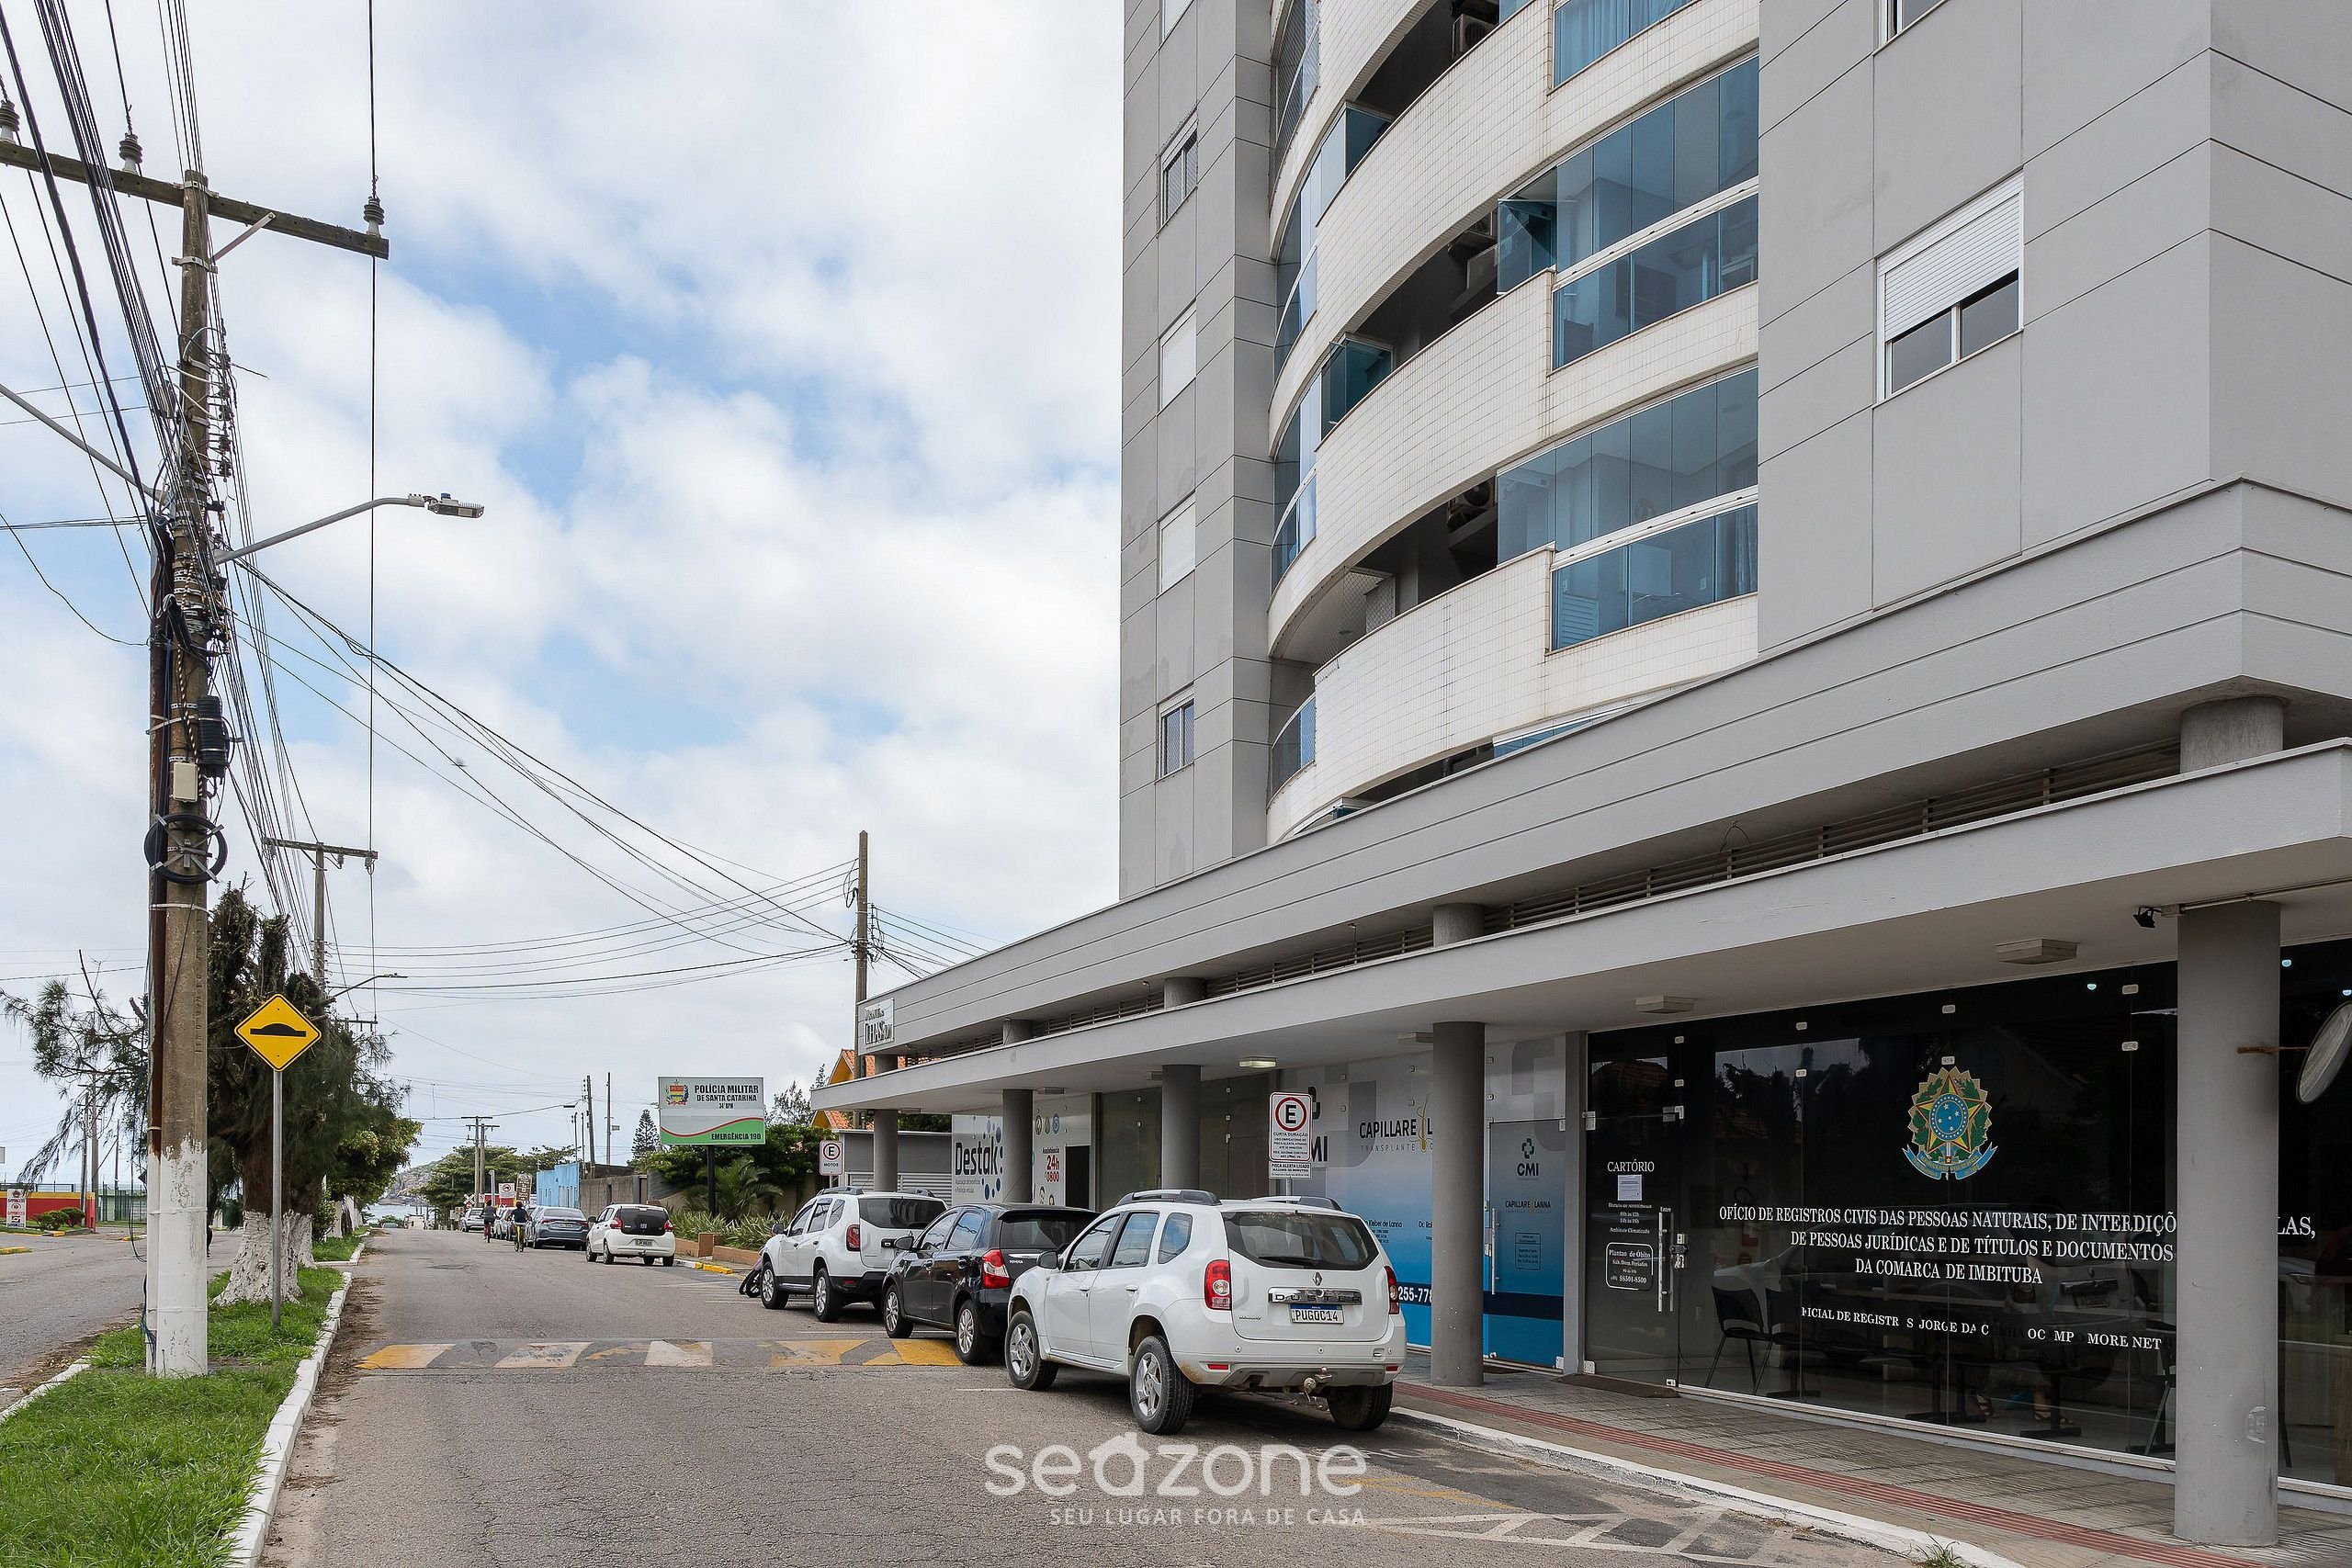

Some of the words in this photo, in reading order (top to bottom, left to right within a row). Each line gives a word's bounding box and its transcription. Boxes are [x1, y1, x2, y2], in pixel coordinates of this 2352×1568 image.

[695, 1083, 727, 1093] POLÍCIA
[728, 1084, 759, 1093] MILITAR
[1285, 1104, 1296, 1124] E
[711, 1132, 749, 1140] EMERGÊNCIA
[1360, 1119, 1417, 1139] CAPILLARE
[829, 1146, 835, 1156] E
[1361, 1143, 1415, 1153] TRANSPLANTE
[956, 1136, 998, 1175] Destak
[1046, 1155, 1059, 1170] 24h
[1517, 1163, 1539, 1176] CMI
[1607, 1158, 1655, 1172] CARTÓRIO
[1505, 1200, 1531, 1208] CAPILLARE
[1534, 1200, 1551, 1208] LANNA
[1720, 1203, 1756, 1221] OFÍCIO
[1758, 1207, 1772, 1221] DE
[1776, 1208, 1841, 1224] REGISTROS
[1844, 1209, 1876, 1224] CIVIS
[1880, 1210, 1905, 1225] DAS
[1908, 1211, 1968, 1228] PESSOAS
[1973, 1212, 2052, 1232] NATURAIS,
[2055, 1213, 2077, 1231] DE
[1791, 1231, 1806, 1246] DE
[1810, 1232, 1861, 1248] PESSOAS
[1865, 1233, 1935, 1252] JURÍDICAS
[1938, 1238, 1947, 1253] E
[1951, 1238, 1970, 1254] DE
[1974, 1235, 2038, 1257] TÍTULOS
[2041, 1240, 2052, 1257] E
[2056, 1240, 2174, 1261] DOCUMENTOS
[1856, 1258, 1872, 1274] DA
[1876, 1259, 1940, 1279] COMARCA
[1946, 1264, 1965, 1280] DE
[1969, 1265, 2042, 1284] IMBITUBA
[1275, 1294, 1360, 1303] DUSTER
[1837, 1310, 1851, 1322] DE
[1919, 1319, 1958, 1333] JORGE
[1962, 1323, 1976, 1334] DA
[2087, 1333, 2129, 1348] MORE
[2132, 1336, 2162, 1350] NET
